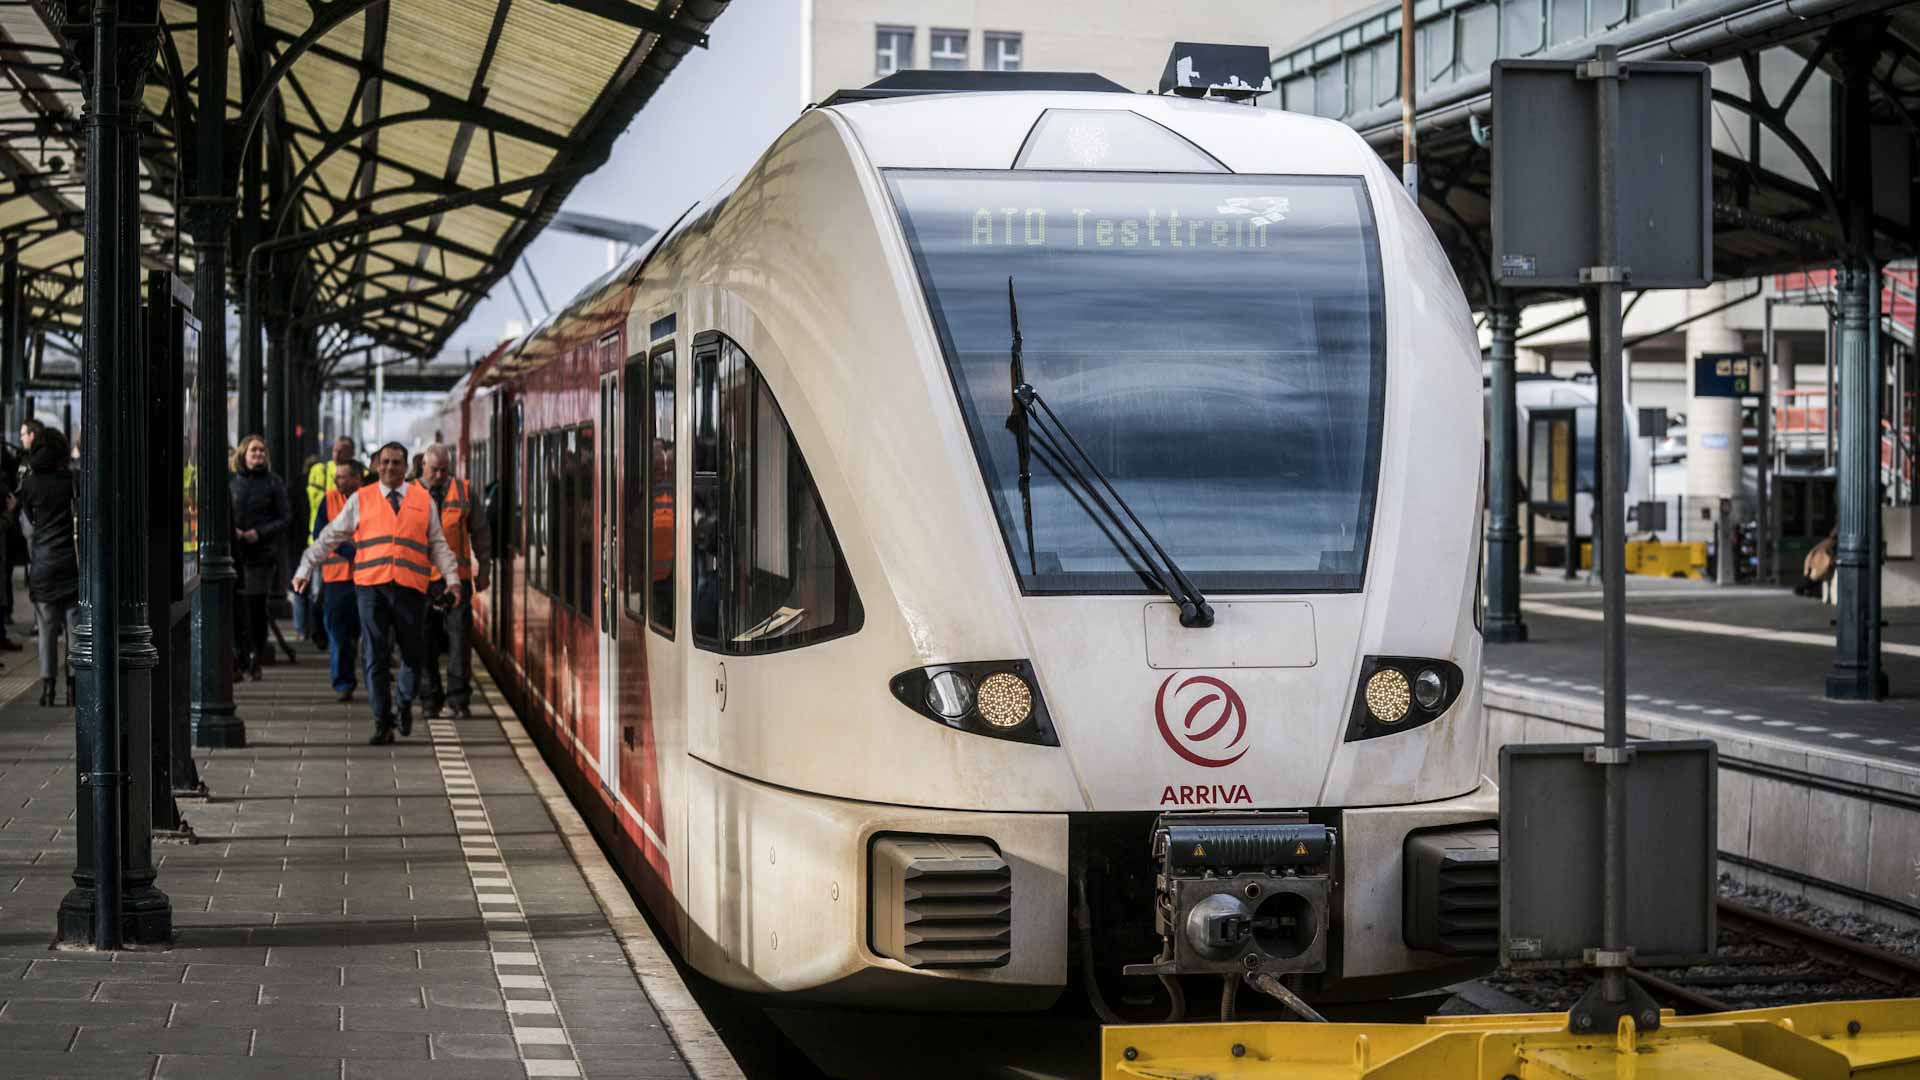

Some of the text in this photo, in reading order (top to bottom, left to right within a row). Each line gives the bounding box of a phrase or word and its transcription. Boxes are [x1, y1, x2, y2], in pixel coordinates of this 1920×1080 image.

[972, 207, 1267, 248] ATO Testtrein
[1160, 784, 1253, 805] ARRIVA
